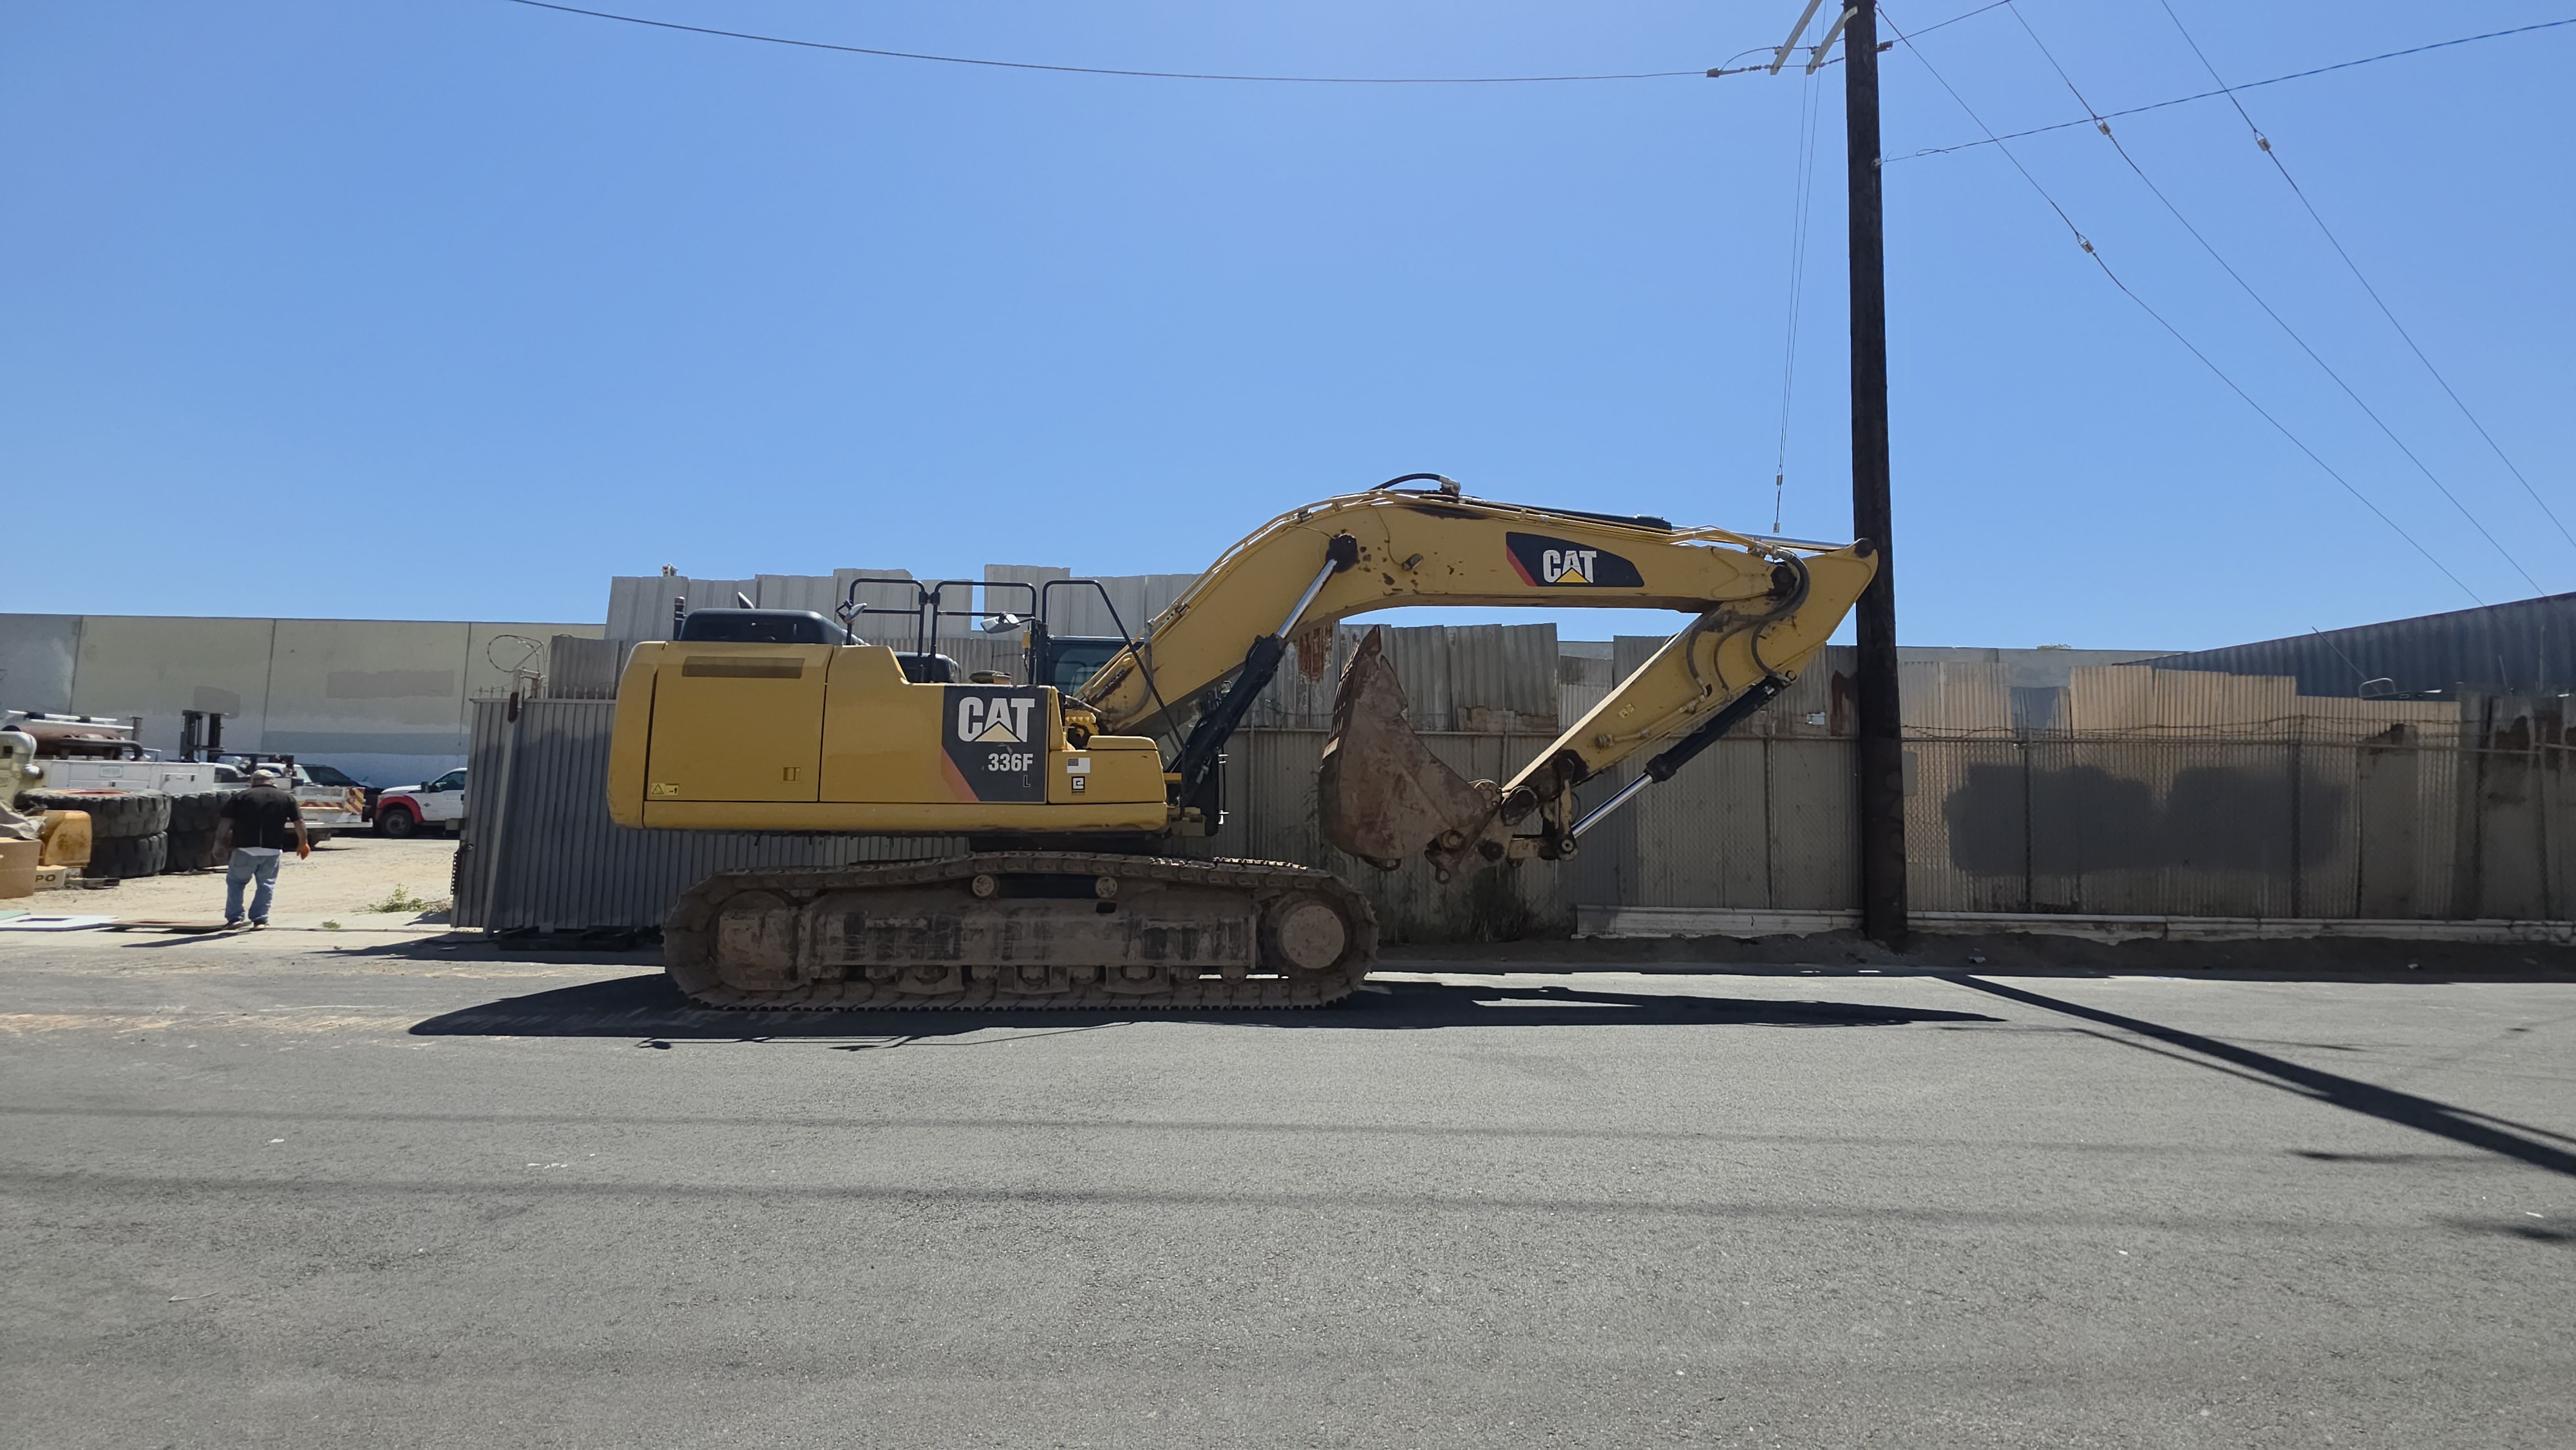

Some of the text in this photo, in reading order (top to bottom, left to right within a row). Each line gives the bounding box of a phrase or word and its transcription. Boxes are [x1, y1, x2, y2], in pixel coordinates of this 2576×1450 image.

[1543, 549, 1596, 583] CAT
[958, 697, 1036, 742] CAT
[988, 753, 1034, 771] 336F
[1023, 775, 1030, 787] L
